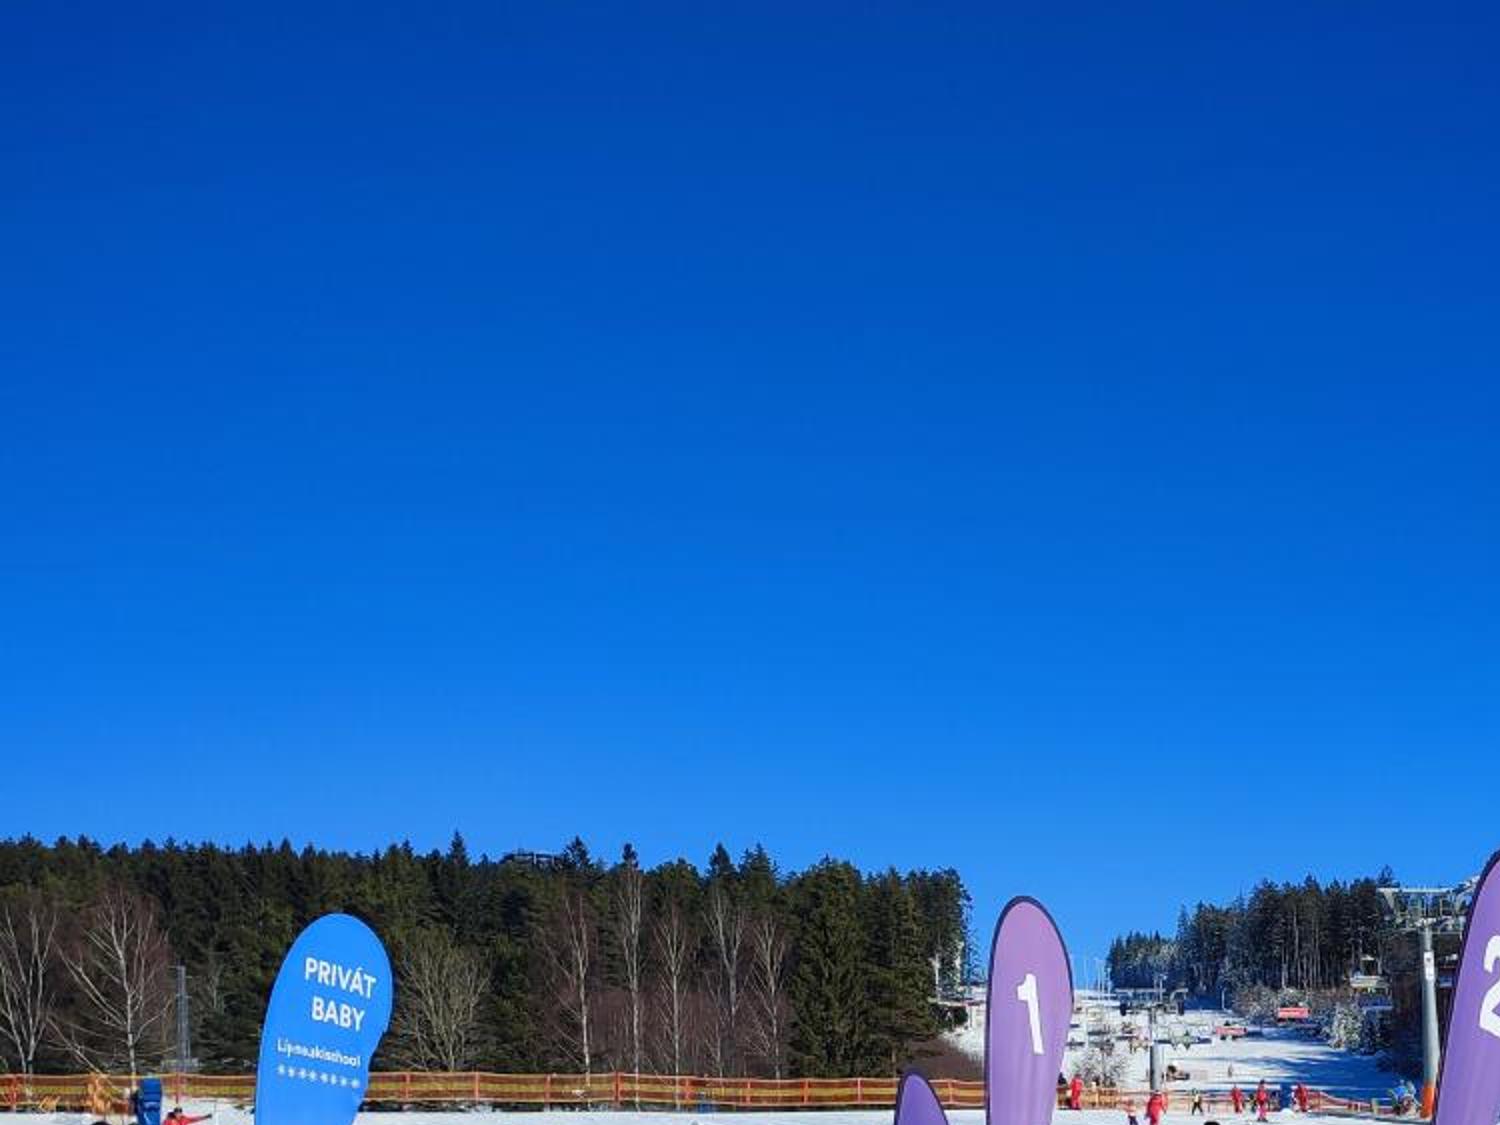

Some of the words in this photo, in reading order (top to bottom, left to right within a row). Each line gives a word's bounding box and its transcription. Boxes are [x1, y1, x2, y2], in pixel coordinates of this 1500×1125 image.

[306, 957, 376, 998] PRIVÁT
[311, 996, 365, 1031] BABY
[1016, 973, 1044, 1054] 1
